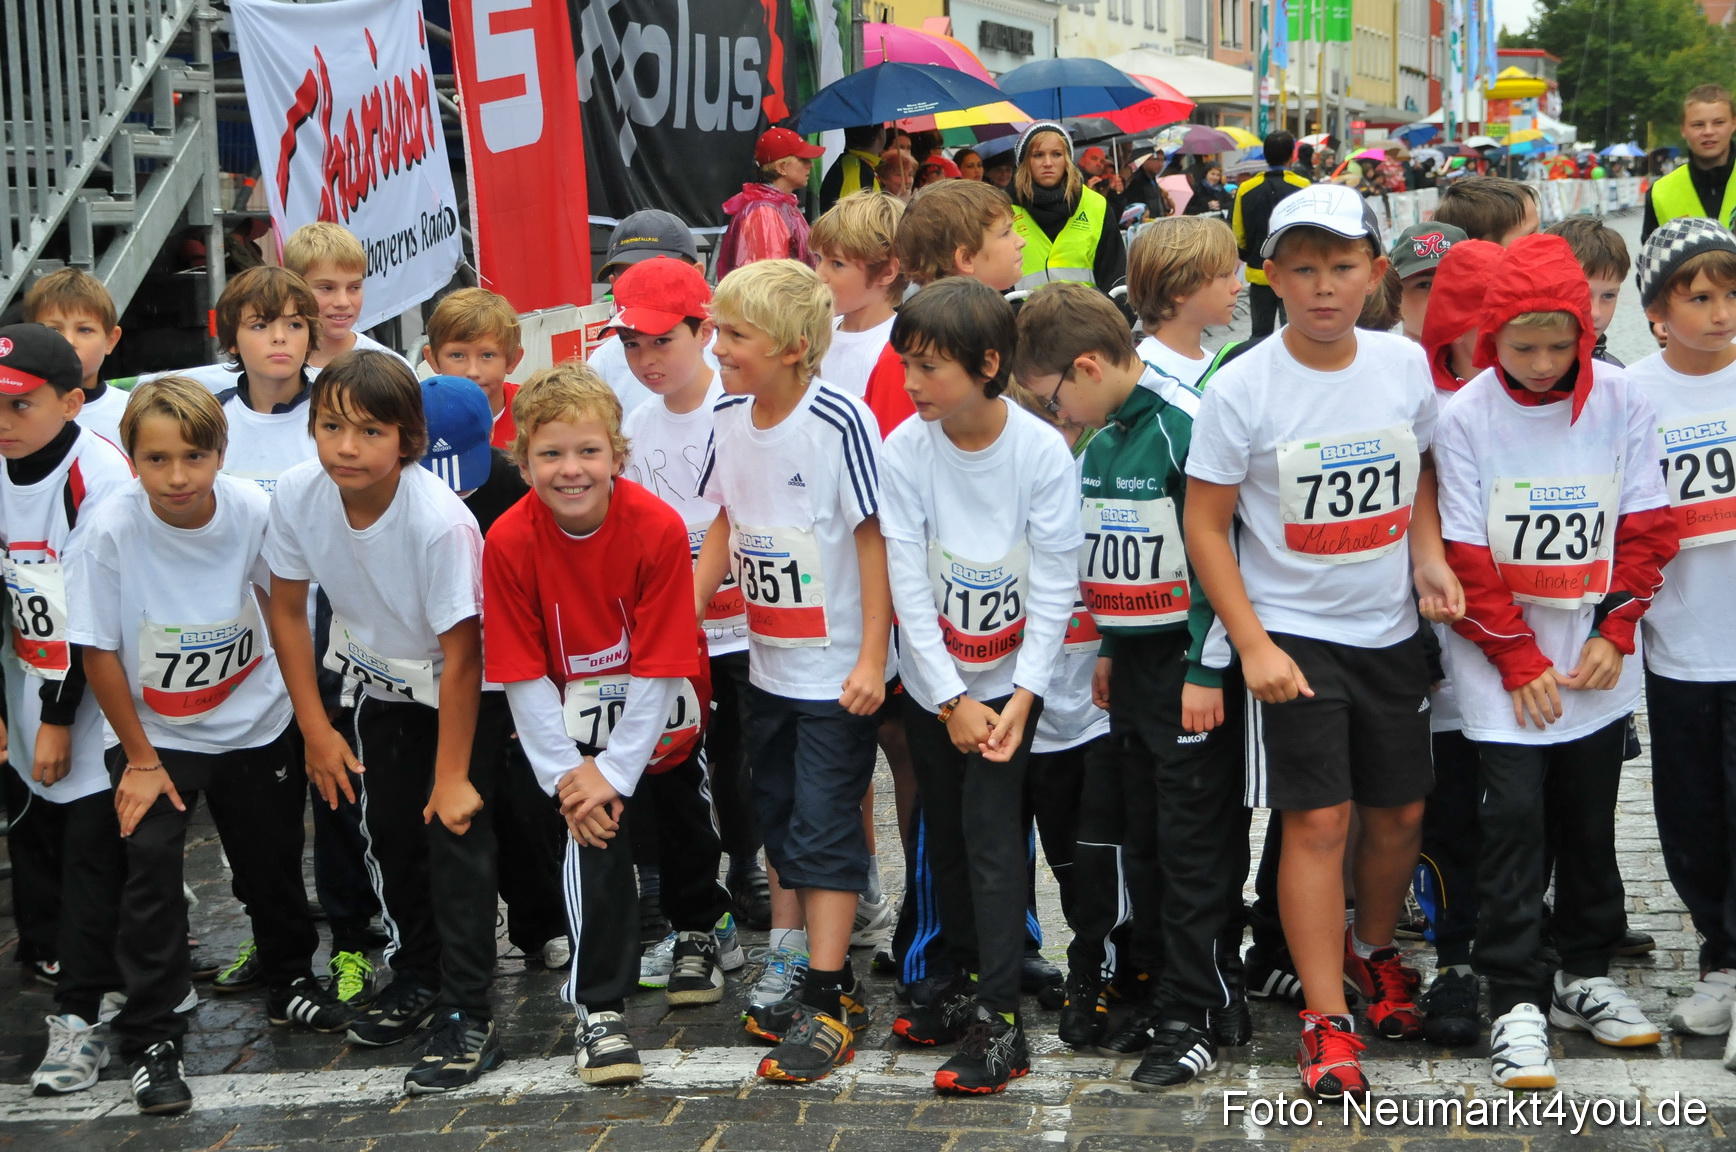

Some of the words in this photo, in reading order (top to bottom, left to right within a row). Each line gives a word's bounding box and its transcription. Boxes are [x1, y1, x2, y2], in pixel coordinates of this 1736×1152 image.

[361, 225, 418, 278] bayerns
[1664, 420, 1727, 445] BOCK
[1321, 439, 1381, 461] BOCK
[1116, 477, 1145, 492] Bergler
[1147, 477, 1158, 491] C.
[1297, 461, 1400, 520] 7321
[1530, 485, 1586, 501] BOCK
[1101, 508, 1139, 522] BOCK
[1297, 523, 1382, 555] Michael
[1505, 510, 1605, 560] 7234
[1085, 533, 1164, 581] 7007
[734, 551, 803, 603] 7351
[952, 562, 1003, 583] BOCK
[1535, 569, 1582, 591] André
[940, 573, 1021, 631] 7125
[1087, 588, 1173, 611] Constantin
[181, 623, 239, 644] BOCK
[943, 626, 1017, 659] Cornelius
[155, 629, 253, 689] 7270
[348, 641, 390, 673] BOCK
[590, 649, 622, 667] DEHN
[580, 695, 686, 747] 700
[1177, 735, 1202, 744] JAKO
